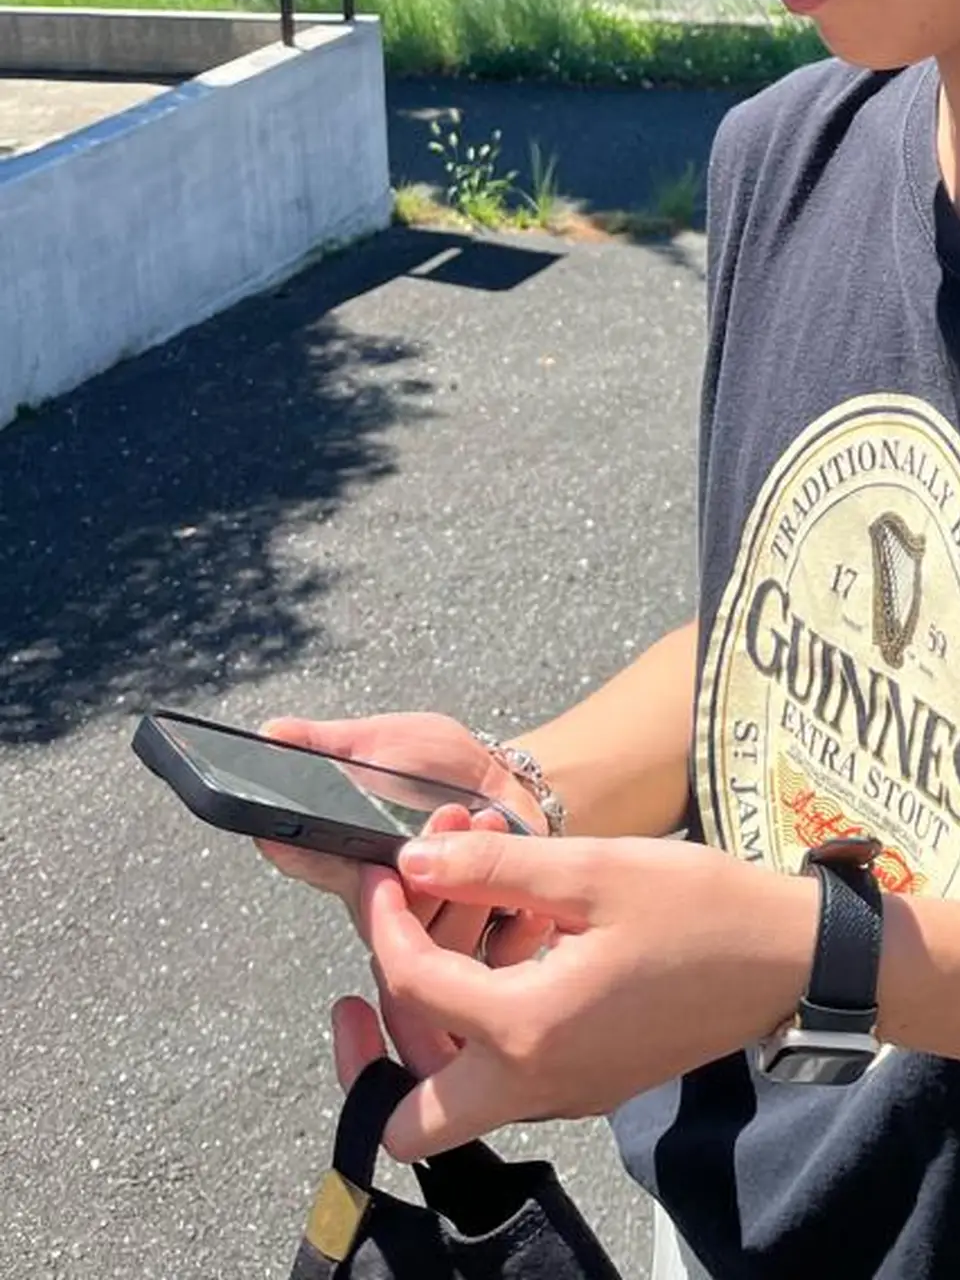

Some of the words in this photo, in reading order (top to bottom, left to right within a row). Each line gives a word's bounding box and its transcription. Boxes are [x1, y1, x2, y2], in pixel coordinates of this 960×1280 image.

[770, 438, 955, 563] TRADITIONALLY
[830, 563, 858, 601] 17
[780, 701, 857, 782] EXTRA
[862, 766, 950, 850] STOUT
